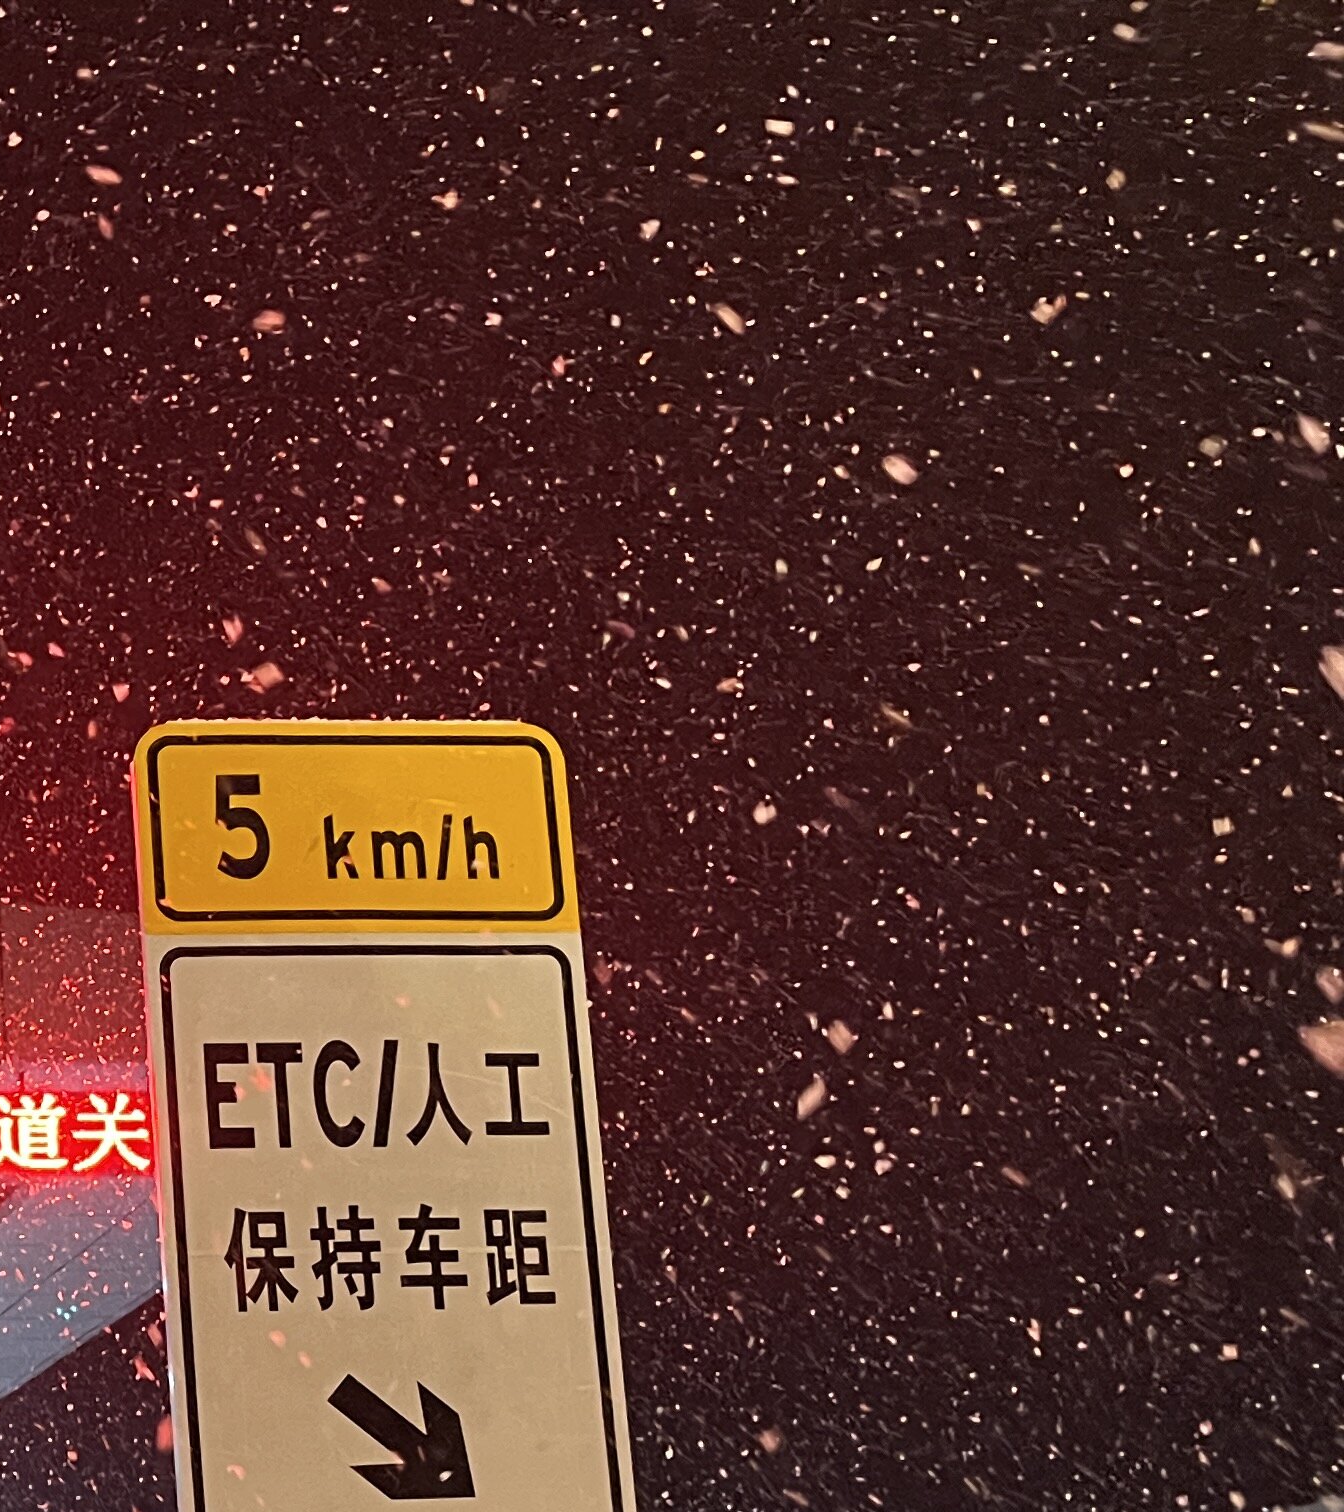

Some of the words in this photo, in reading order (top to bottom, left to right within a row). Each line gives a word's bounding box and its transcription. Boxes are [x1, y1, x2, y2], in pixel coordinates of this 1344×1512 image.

[215, 773, 271, 880] 5
[323, 814, 501, 881] km/h
[202, 1039, 551, 1149] ETC/人工
[223, 1203, 557, 1312] 保持车距
